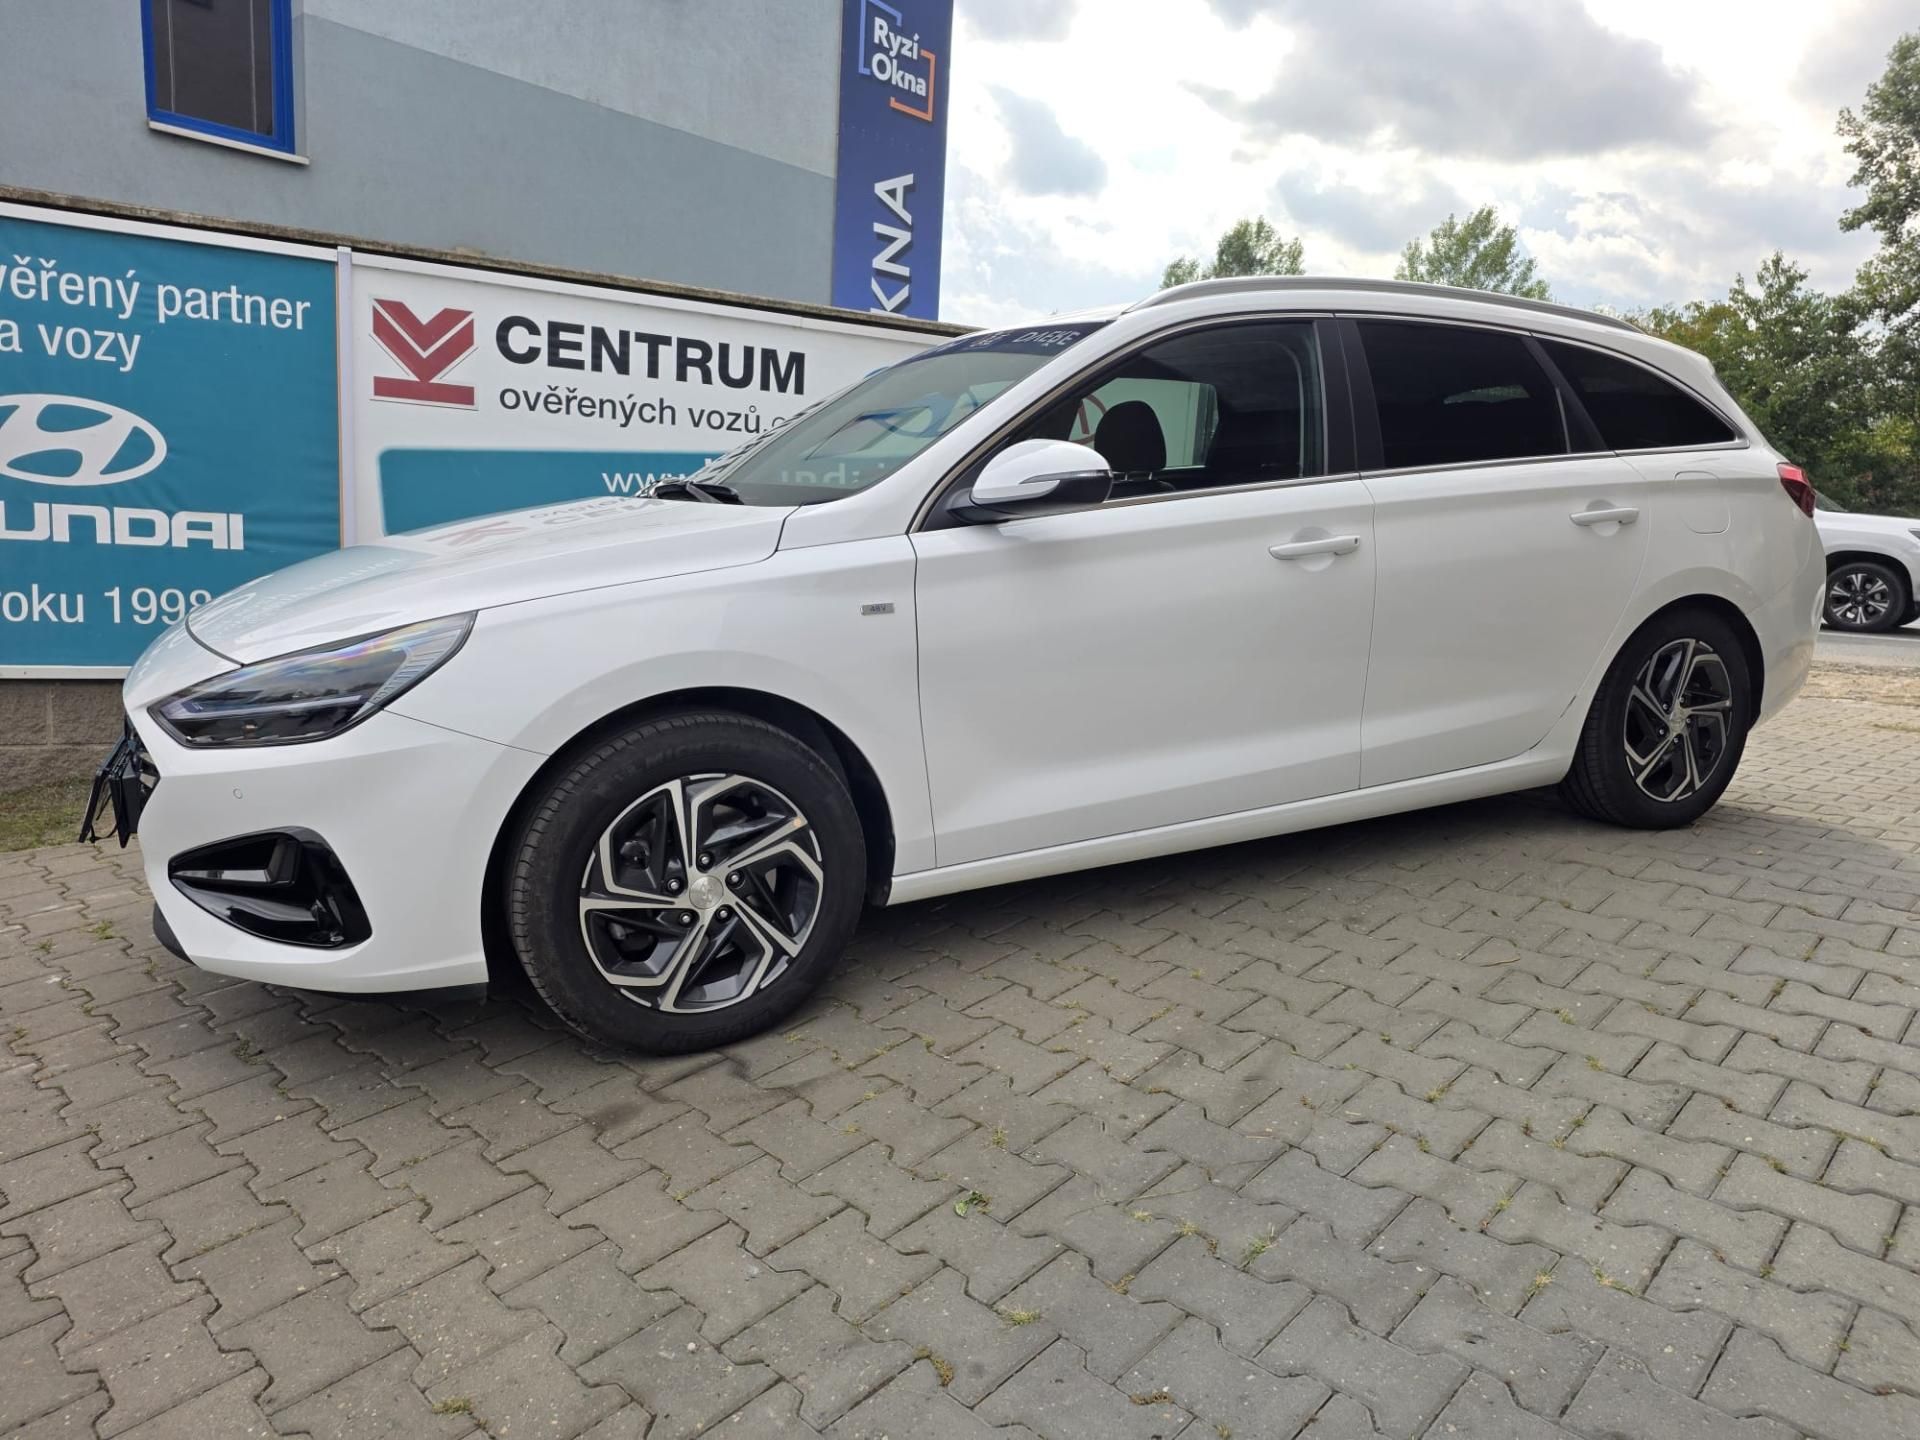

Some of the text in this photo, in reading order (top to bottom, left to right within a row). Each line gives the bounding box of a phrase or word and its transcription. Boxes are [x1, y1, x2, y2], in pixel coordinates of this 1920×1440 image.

[871, 52, 927, 97] Okna
[0, 254, 311, 330] ěřený partner
[37, 323, 141, 372] vozy
[495, 315, 806, 396] CENTRUM
[499, 384, 677, 428] ověřených
[0, 583, 85, 623] oku
